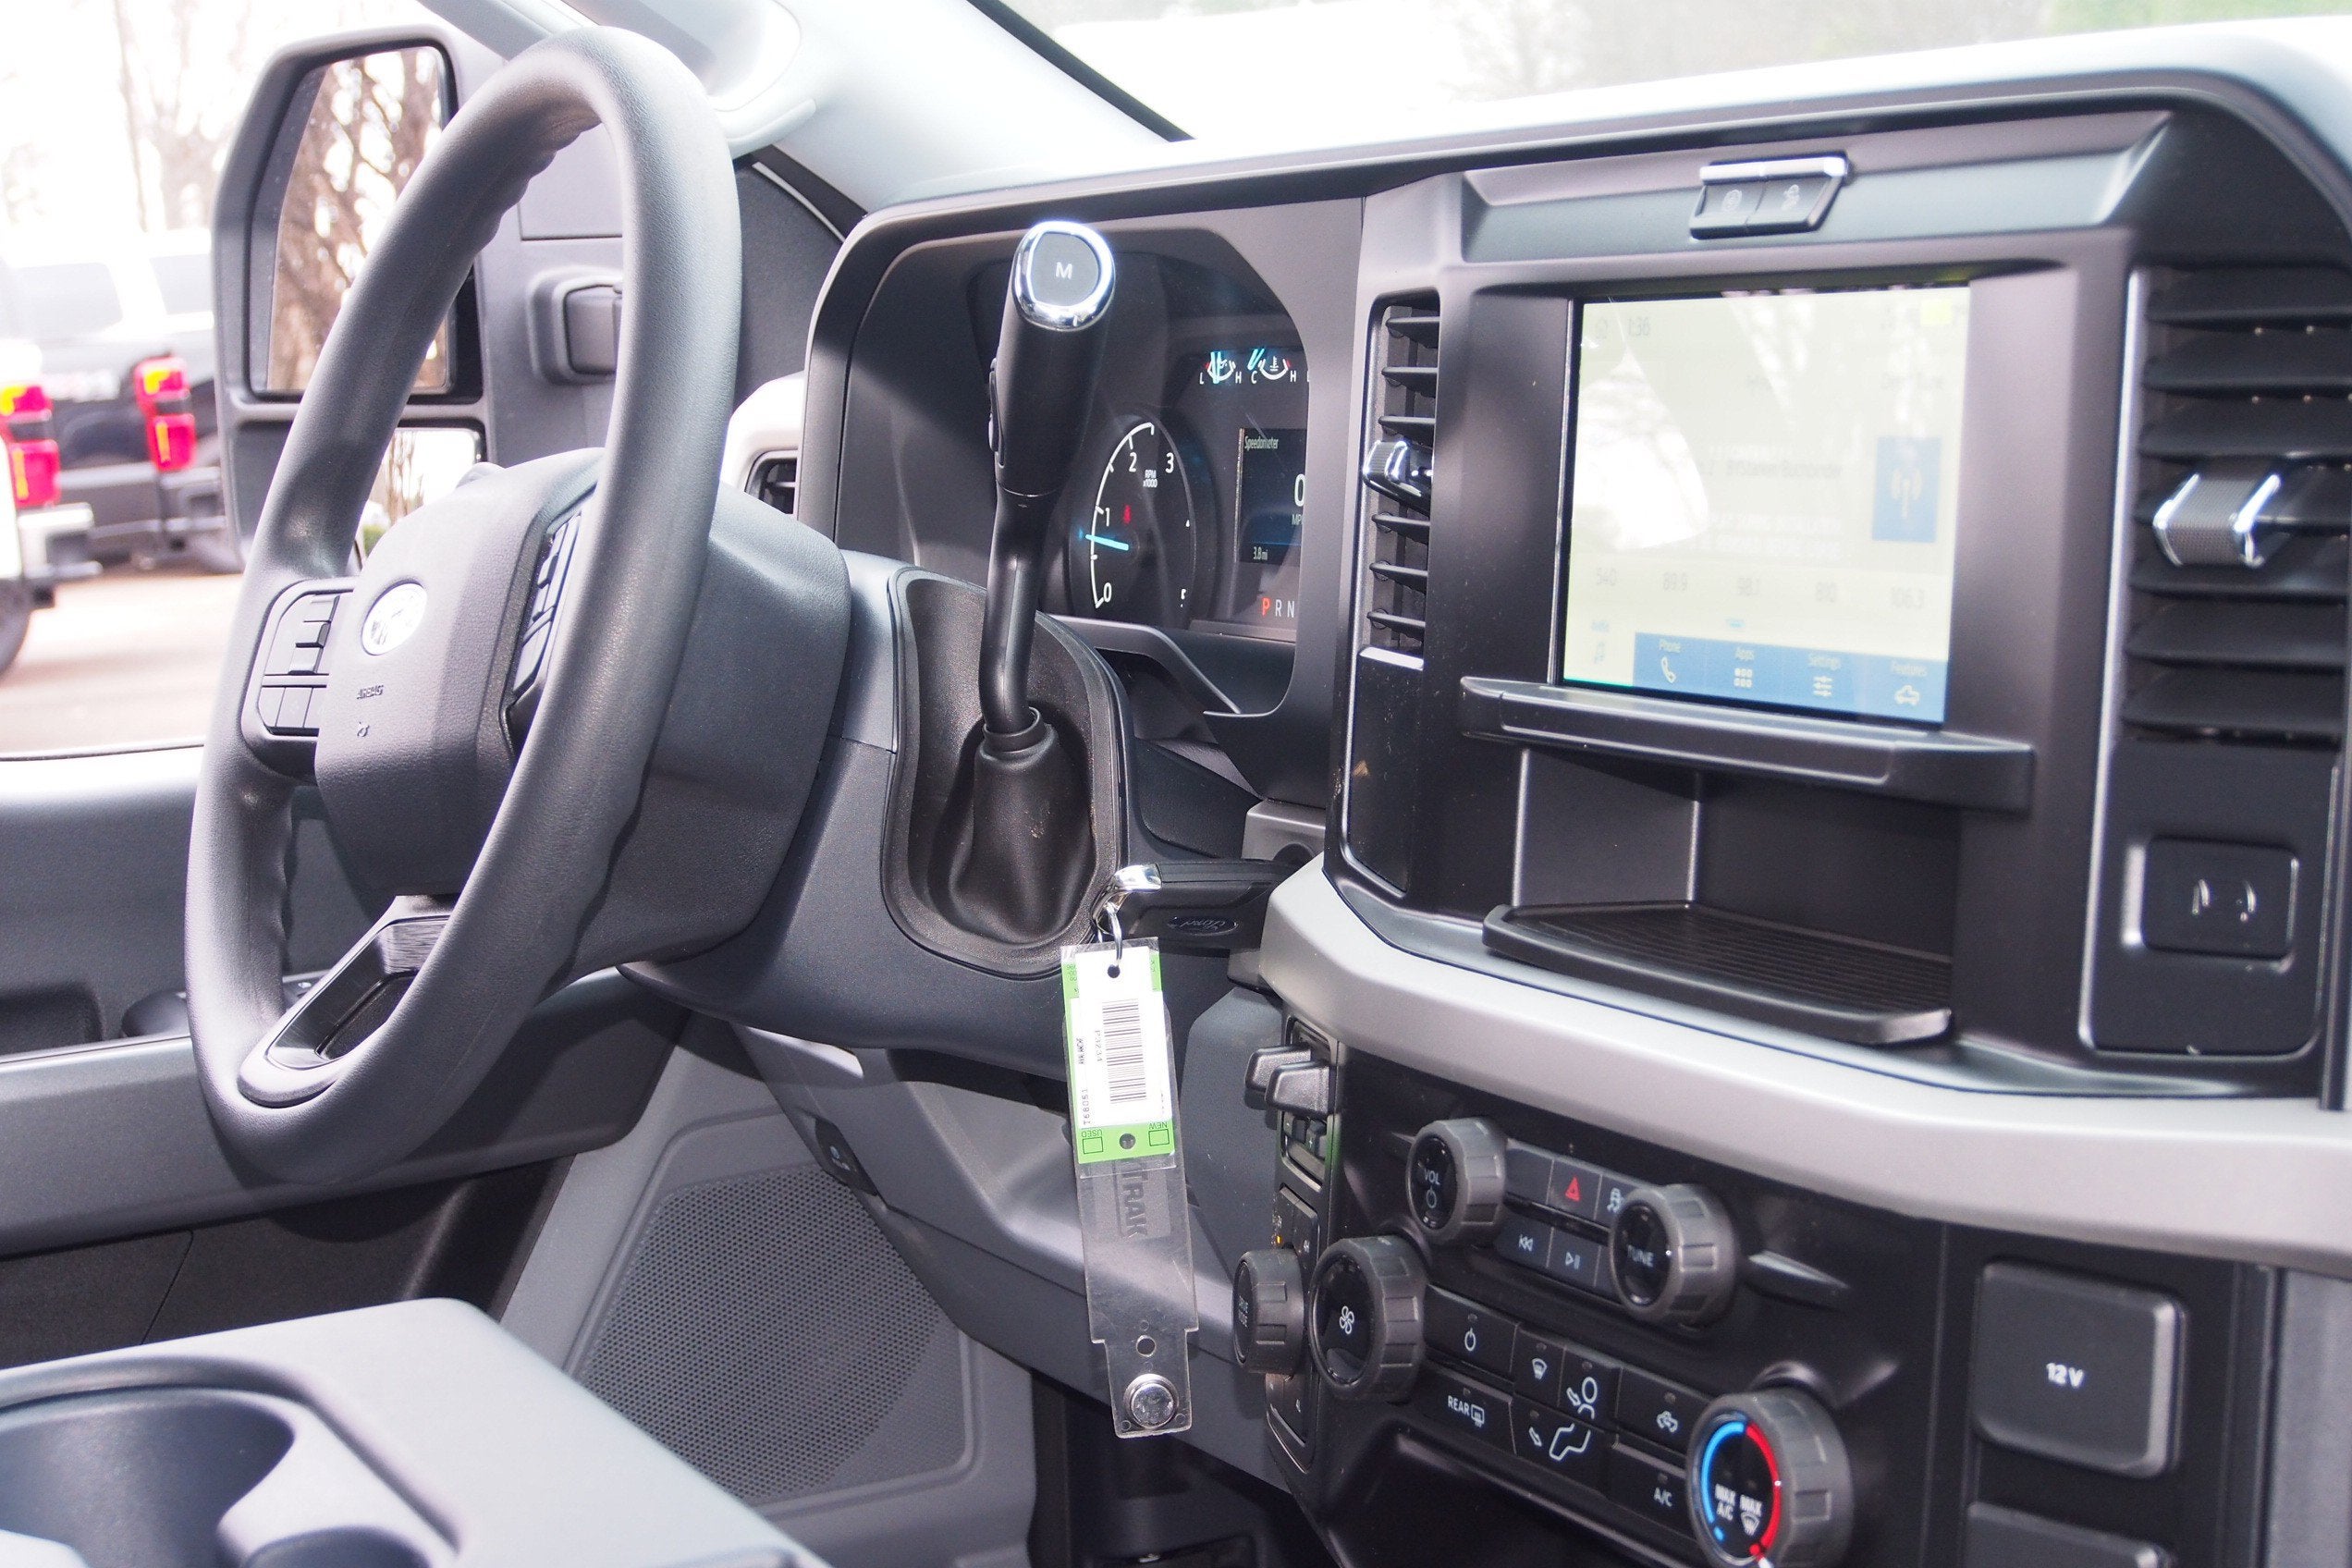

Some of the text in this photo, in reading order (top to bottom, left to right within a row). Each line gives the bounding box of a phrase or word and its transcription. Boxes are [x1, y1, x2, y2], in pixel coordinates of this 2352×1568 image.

[1055, 262, 1072, 279] M
[1199, 372, 1204, 385] L
[1235, 371, 1242, 384] H
[1251, 371, 1257, 384] C
[1290, 370, 1296, 383] H
[1129, 452, 1137, 472] 2
[1165, 452, 1174, 473] 3
[1104, 508, 1109, 527] 1
[1292, 513, 1302, 525] MP
[1103, 582, 1112, 602] 0
[1262, 597, 1294, 619] P R N
[1081, 1129, 1103, 1138] USED
[1148, 1121, 1169, 1131] NEW
[1425, 1169, 1440, 1185] VOL
[1448, 1395, 1470, 1416] REAR
[1654, 1488, 1672, 1507] A/C
